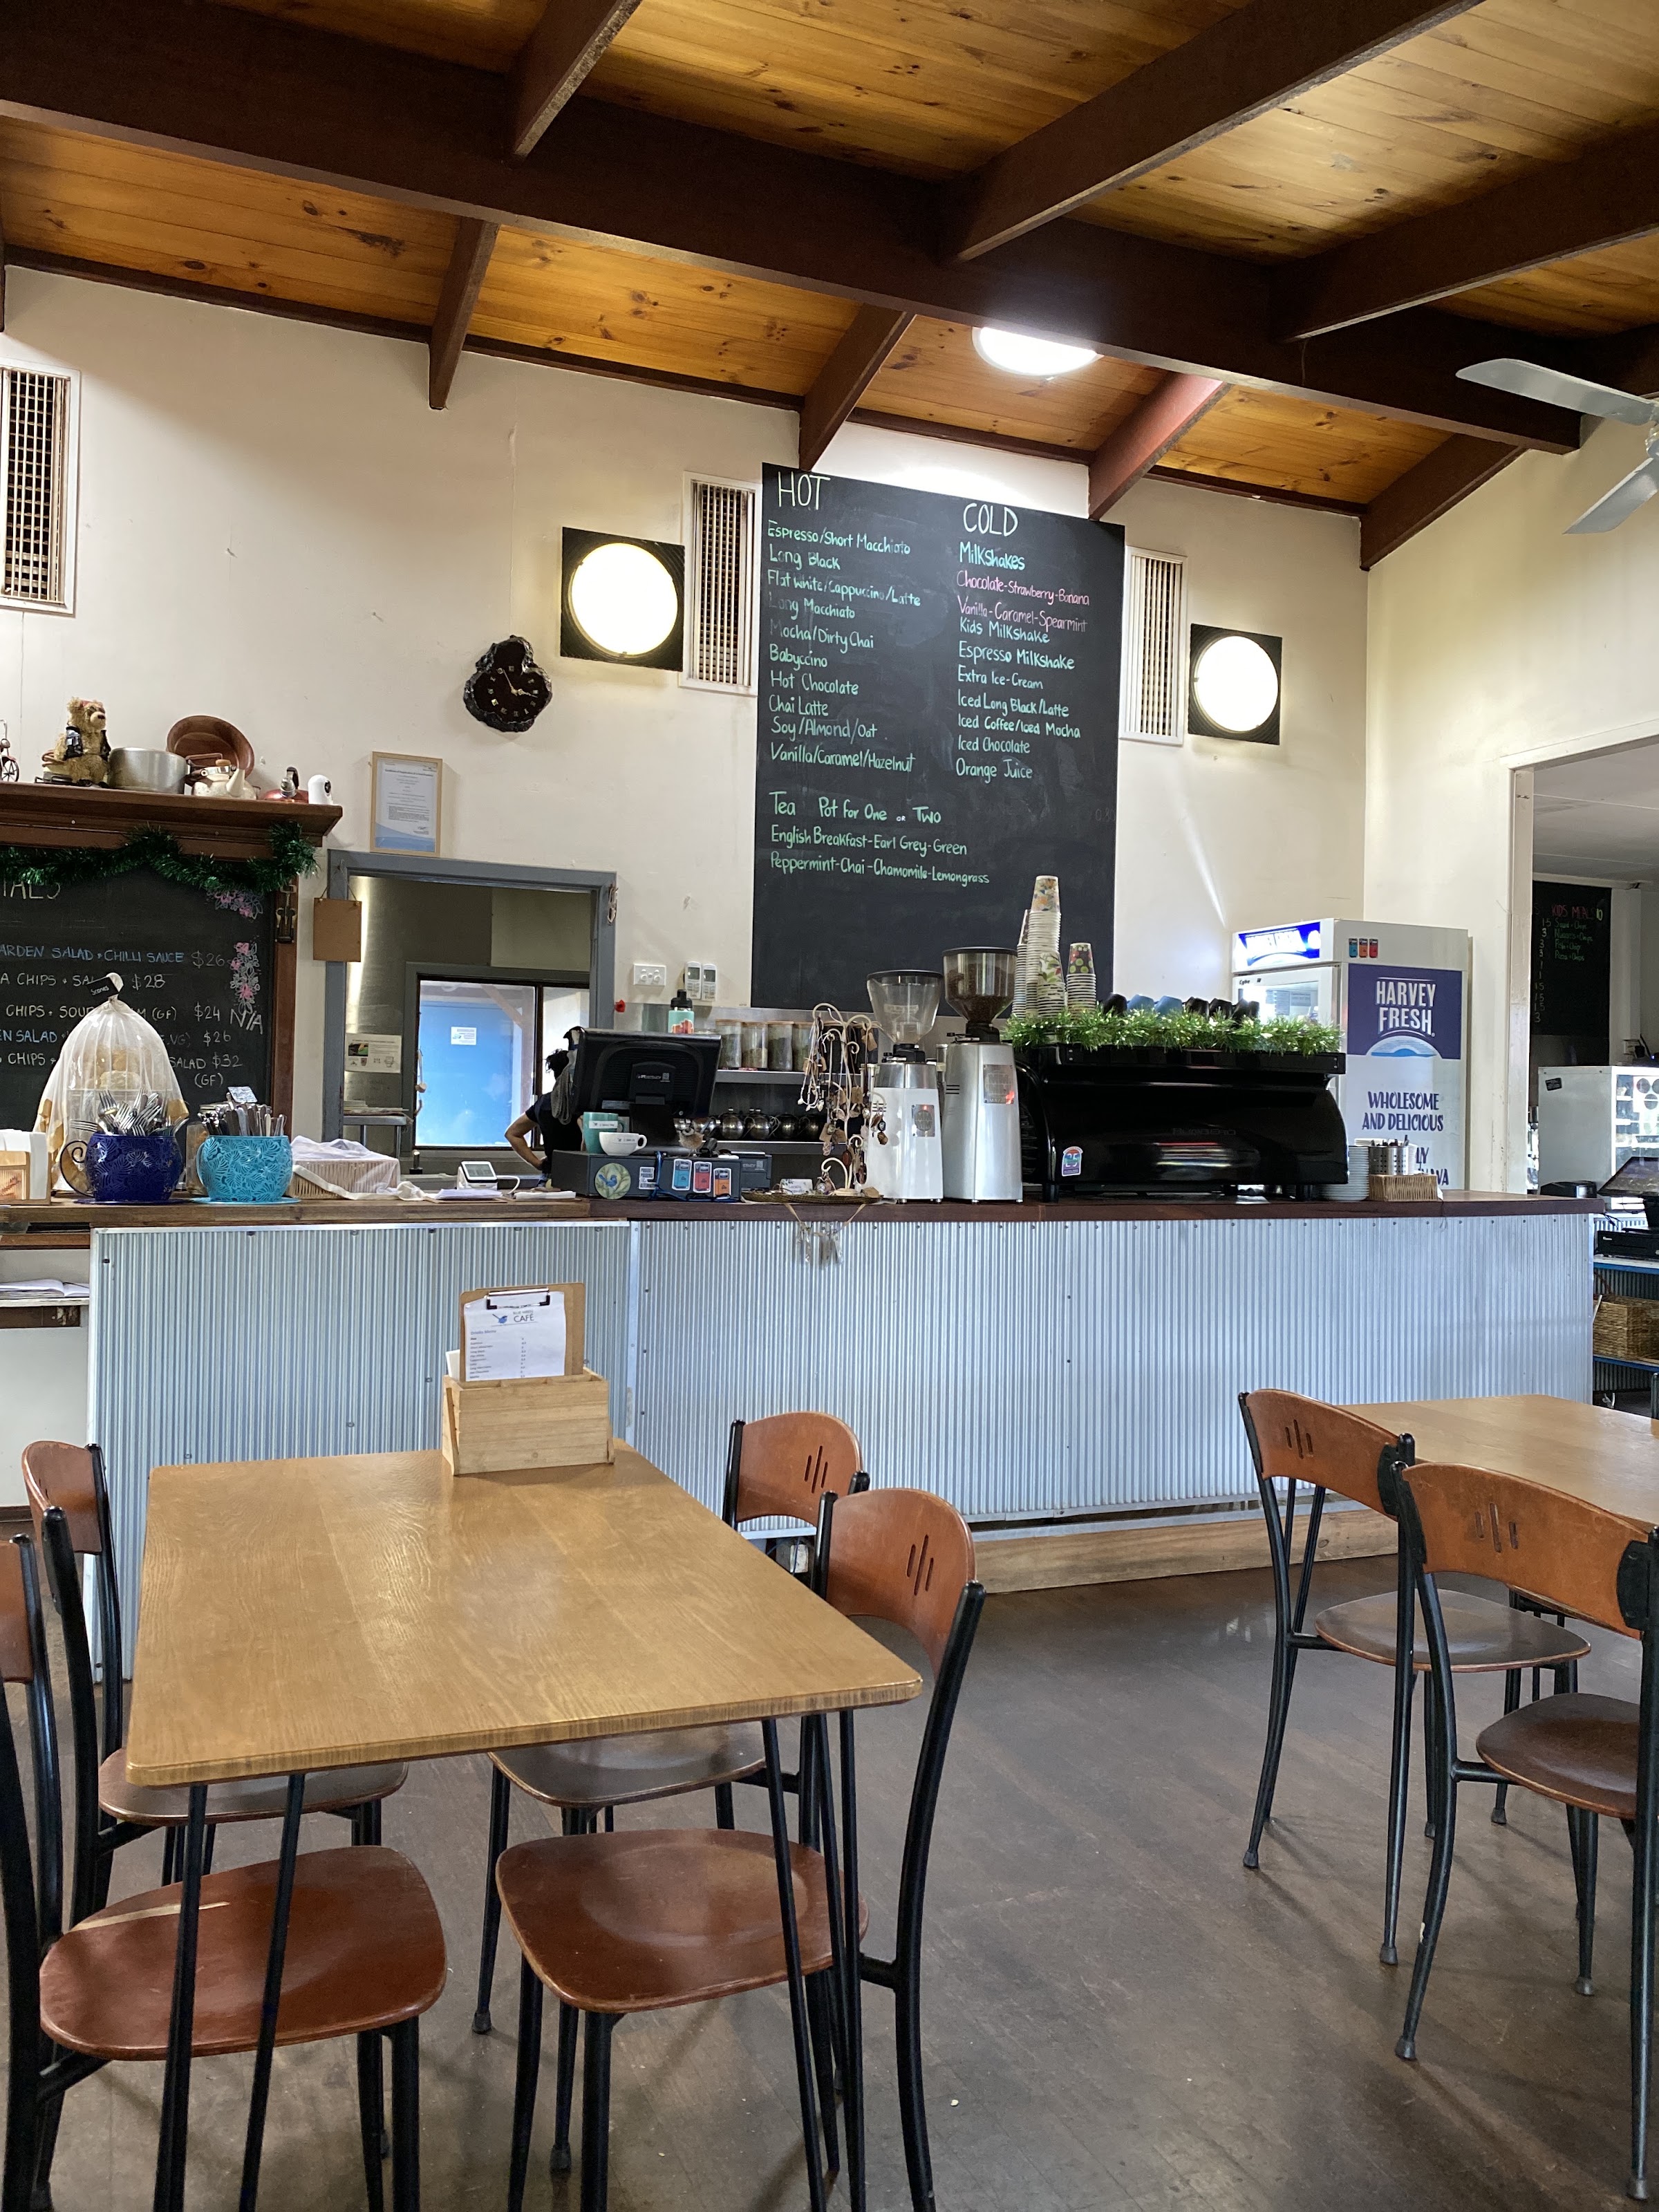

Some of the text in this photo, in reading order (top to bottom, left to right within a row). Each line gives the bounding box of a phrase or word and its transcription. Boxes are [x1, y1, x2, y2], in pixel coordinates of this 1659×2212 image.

[778, 471, 831, 510] HOT
[963, 503, 1018, 536] COLD
[768, 520, 910, 554] Espresso/Short Macchiato
[769, 543, 841, 570] Long Black
[768, 570, 791, 587] Flat
[804, 597, 855, 619] Macchiato
[960, 617, 983, 634] Kids
[850, 630, 874, 648] Chai
[769, 644, 827, 671] Babyccino
[959, 640, 1012, 665] Espresso
[771, 670, 859, 695] Hot Chocolate
[958, 664, 1044, 689] Extra Ice-Cream
[769, 694, 829, 716] Chai Latte
[958, 689, 982, 708] Iced
[983, 693, 1008, 717] Long
[958, 713, 980, 729] Iced
[1046, 722, 1081, 738] Mocha
[958, 735, 1030, 753] Iced Chocolate
[956, 758, 1033, 784] Orange Juice
[769, 791, 796, 816] Tea
[818, 796, 838, 817] Pot
[865, 803, 888, 821] One
[912, 806, 941, 823] Two
[771, 825, 812, 848] English
[52, 946, 93, 961] SALAD
[147, 952, 185, 963] SAUCE
[17, 973, 57, 986] CHIPS
[131, 973, 166, 991] $28
[1376, 980, 1436, 1008] HARVEY
[6, 1004, 46, 1018] CHIPS
[151, 1006, 177, 1021] (GF)
[194, 1002, 221, 1022] $24
[229, 1008, 263, 1035] N/A
[1378, 1006, 1433, 1036] FRESH
[15, 1029, 57, 1043] SALAD
[8, 1052, 46, 1067] CHIPS
[212, 1051, 242, 1069] $32
[194, 1073, 224, 1088] (GF)
[1367, 1091, 1440, 1110] WHOLESOME
[1362, 1112, 1444, 1132] AND DELICIOUS
[514, 1314, 534, 1323] CAFÉ
